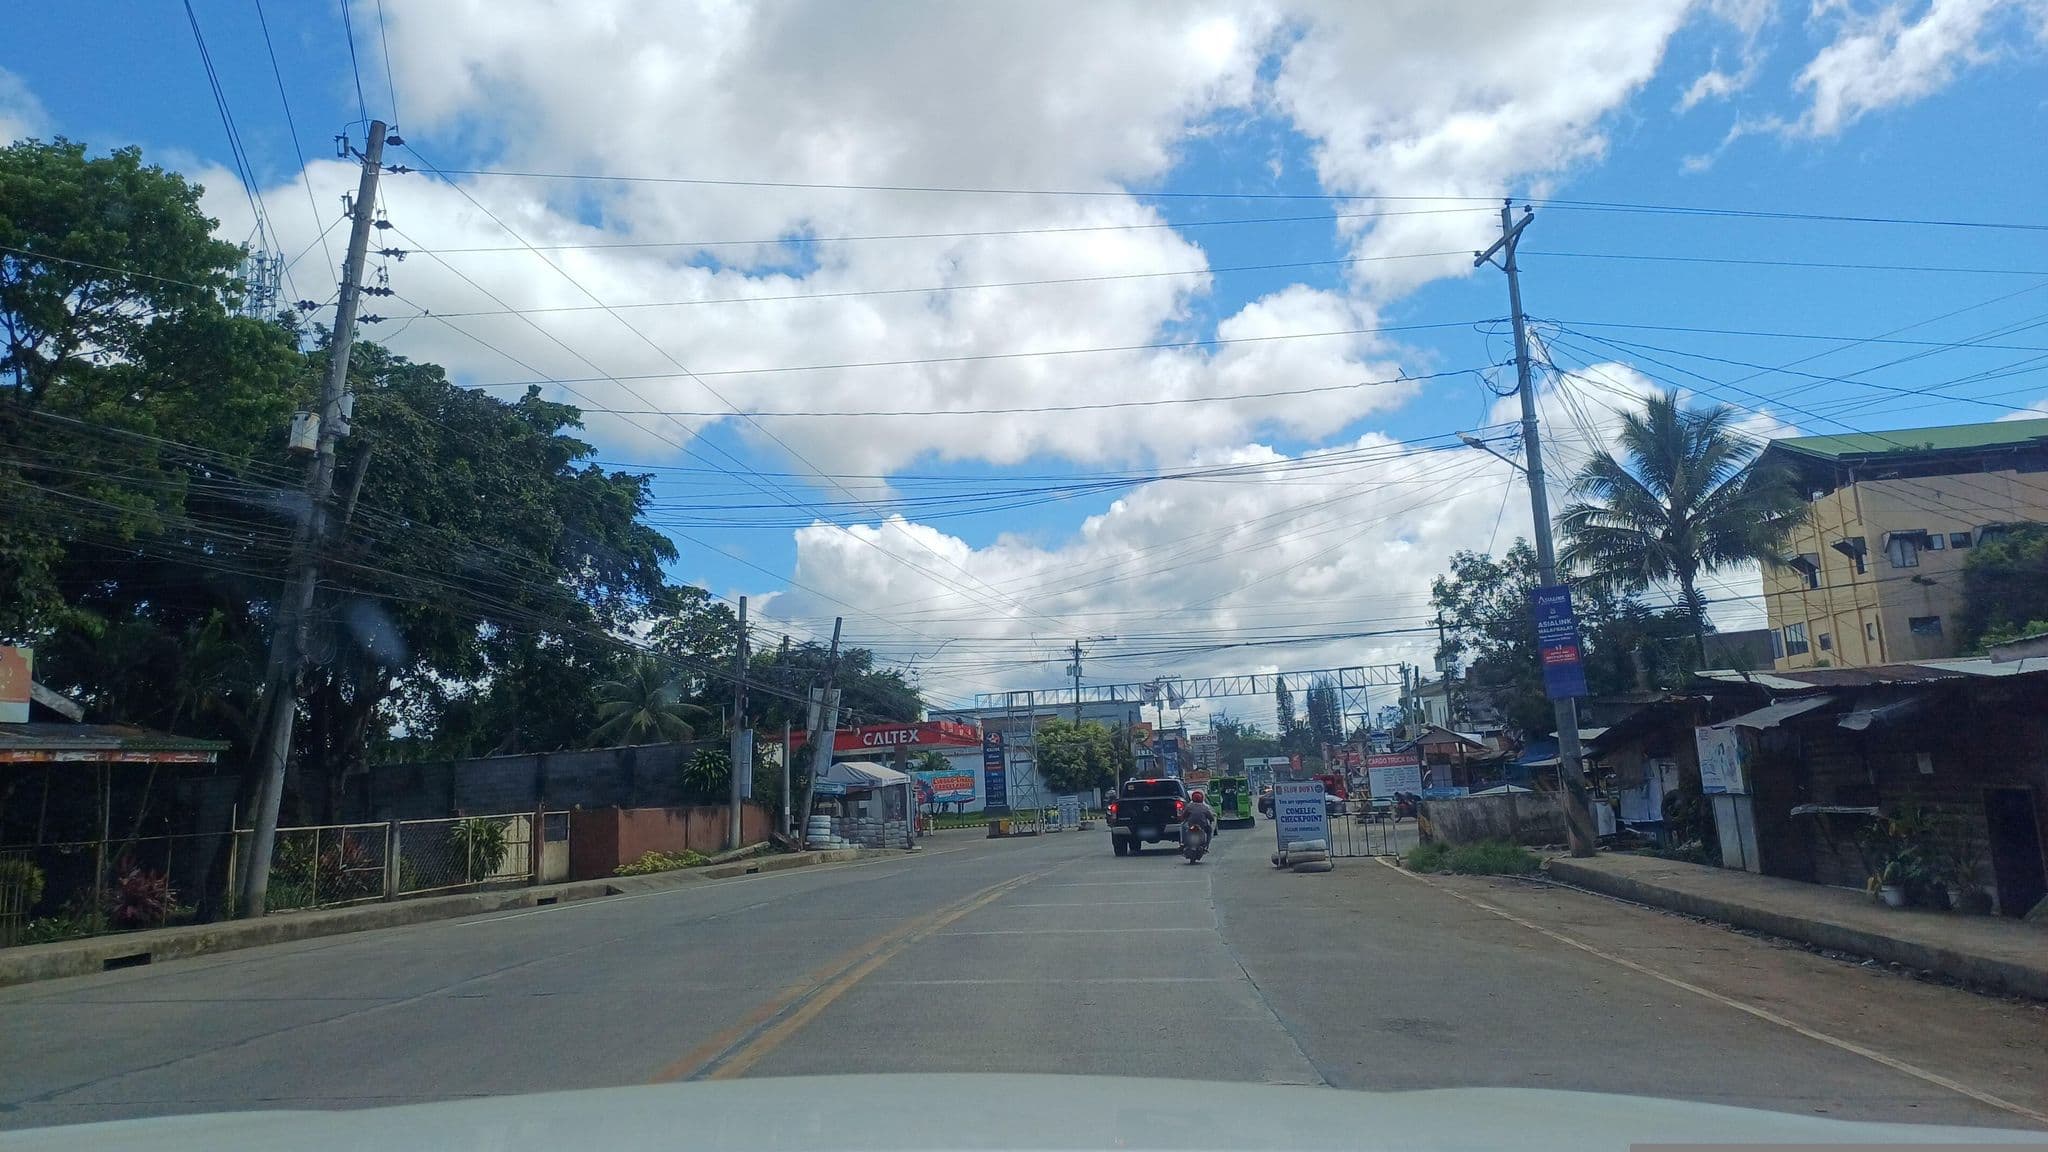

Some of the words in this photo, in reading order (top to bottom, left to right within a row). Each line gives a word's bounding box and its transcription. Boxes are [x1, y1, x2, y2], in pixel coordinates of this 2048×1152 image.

[1538, 618, 1571, 628] ASIALINK
[863, 728, 920, 746] CALTEX
[1280, 815, 1322, 823] CHECKPOINT
